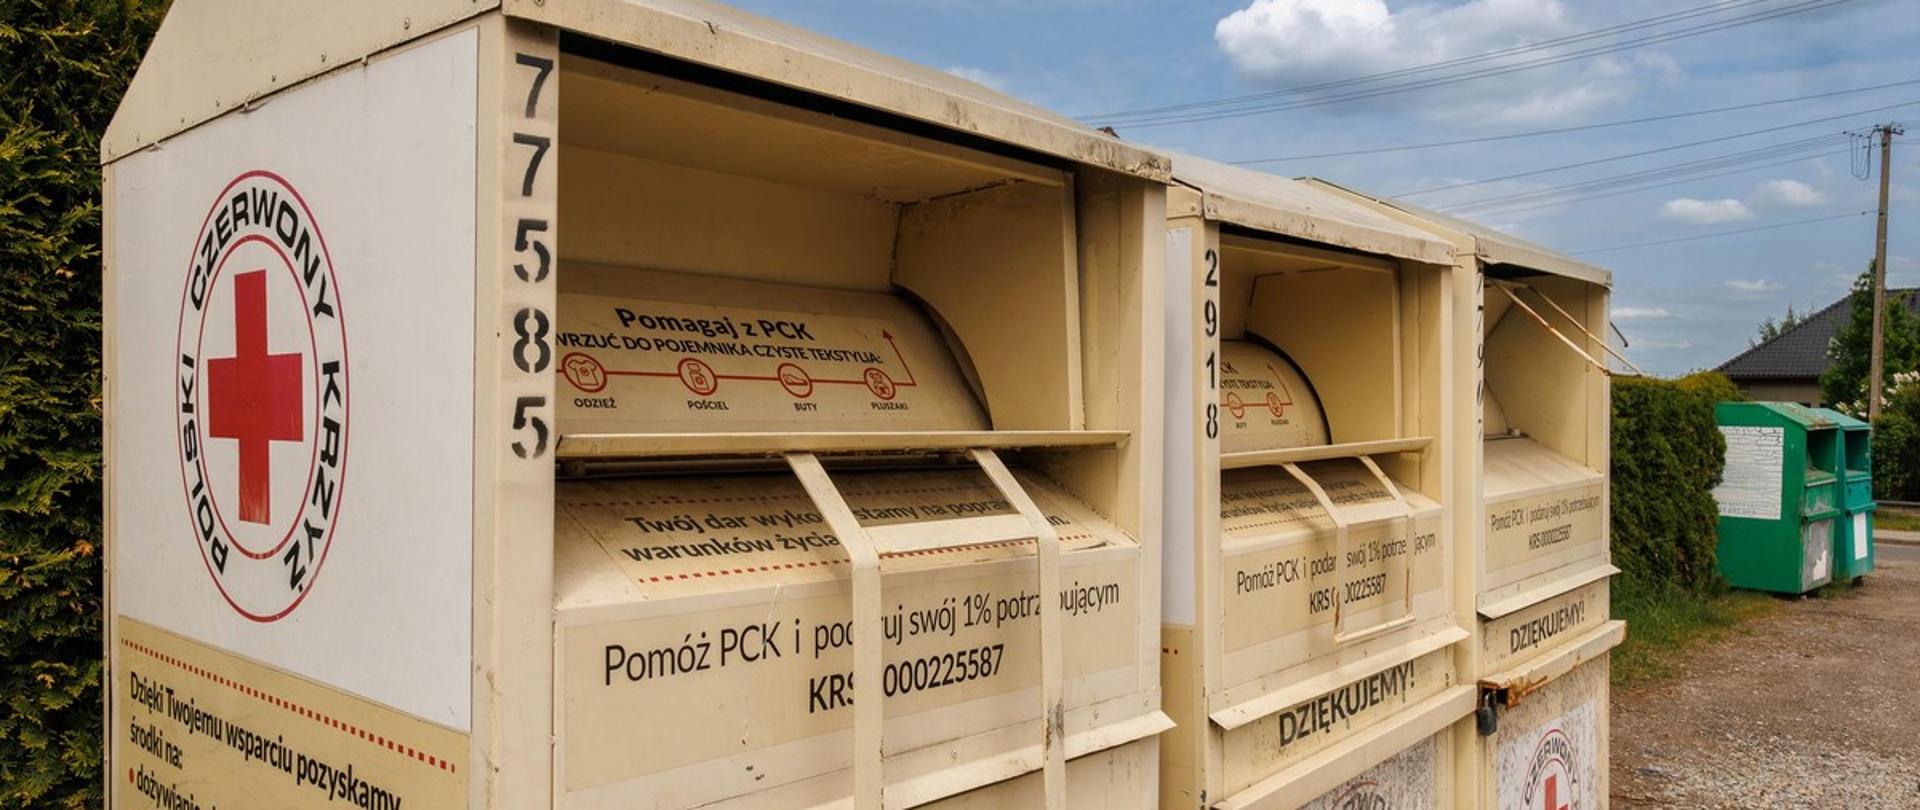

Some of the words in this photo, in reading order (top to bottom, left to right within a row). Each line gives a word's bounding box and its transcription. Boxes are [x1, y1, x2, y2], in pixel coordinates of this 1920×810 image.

[190, 187, 335, 320] CZERWONY
[511, 52, 554, 460] 77585
[614, 307, 739, 340] Pomagaj
[740, 322, 758, 337] z
[757, 319, 816, 341] PCK
[621, 335, 652, 351] DO
[652, 338, 753, 357] POJEMNIKA
[753, 344, 810, 361] CZYSTE
[807, 347, 884, 365] TEKSTYLIA:
[1204, 248, 1219, 440] 2918
[574, 397, 617, 409] ODZIEŻ
[687, 399, 730, 411] POŚCIEL
[793, 402, 818, 412] BUTY
[181, 353, 229, 576] POLSKI
[282, 360, 341, 593] KRZYŻ
[625, 514, 705, 535] Twój
[704, 513, 749, 531] dar
[919, 501, 947, 516] na
[622, 537, 775, 562] warunków
[775, 532, 841, 551] życia
[1237, 563, 1275, 594] Pomóż
[1276, 558, 1300, 585] PCK
[1303, 556, 1307, 578] i
[1346, 542, 1367, 569] swój
[1367, 540, 1381, 562] 1%
[1309, 588, 1331, 615] KRS
[1510, 600, 1585, 655] DZIĘKUJEMY!
[605, 631, 711, 686] Pomóż
[720, 621, 781, 667] PCK
[794, 618, 801, 654] i
[909, 597, 956, 637] swój
[963, 593, 992, 628] 1%
[882, 643, 1004, 698] 000225587
[130, 671, 164, 714] Dzięki
[166, 687, 222, 741] Twojemu
[225, 721, 292, 774] wsparciu
[1278, 660, 1416, 748] DZIĘKUJEMY!
[130, 715, 163, 759] środki
[165, 741, 183, 770] na:
[136, 763, 201, 810] dożywiani
